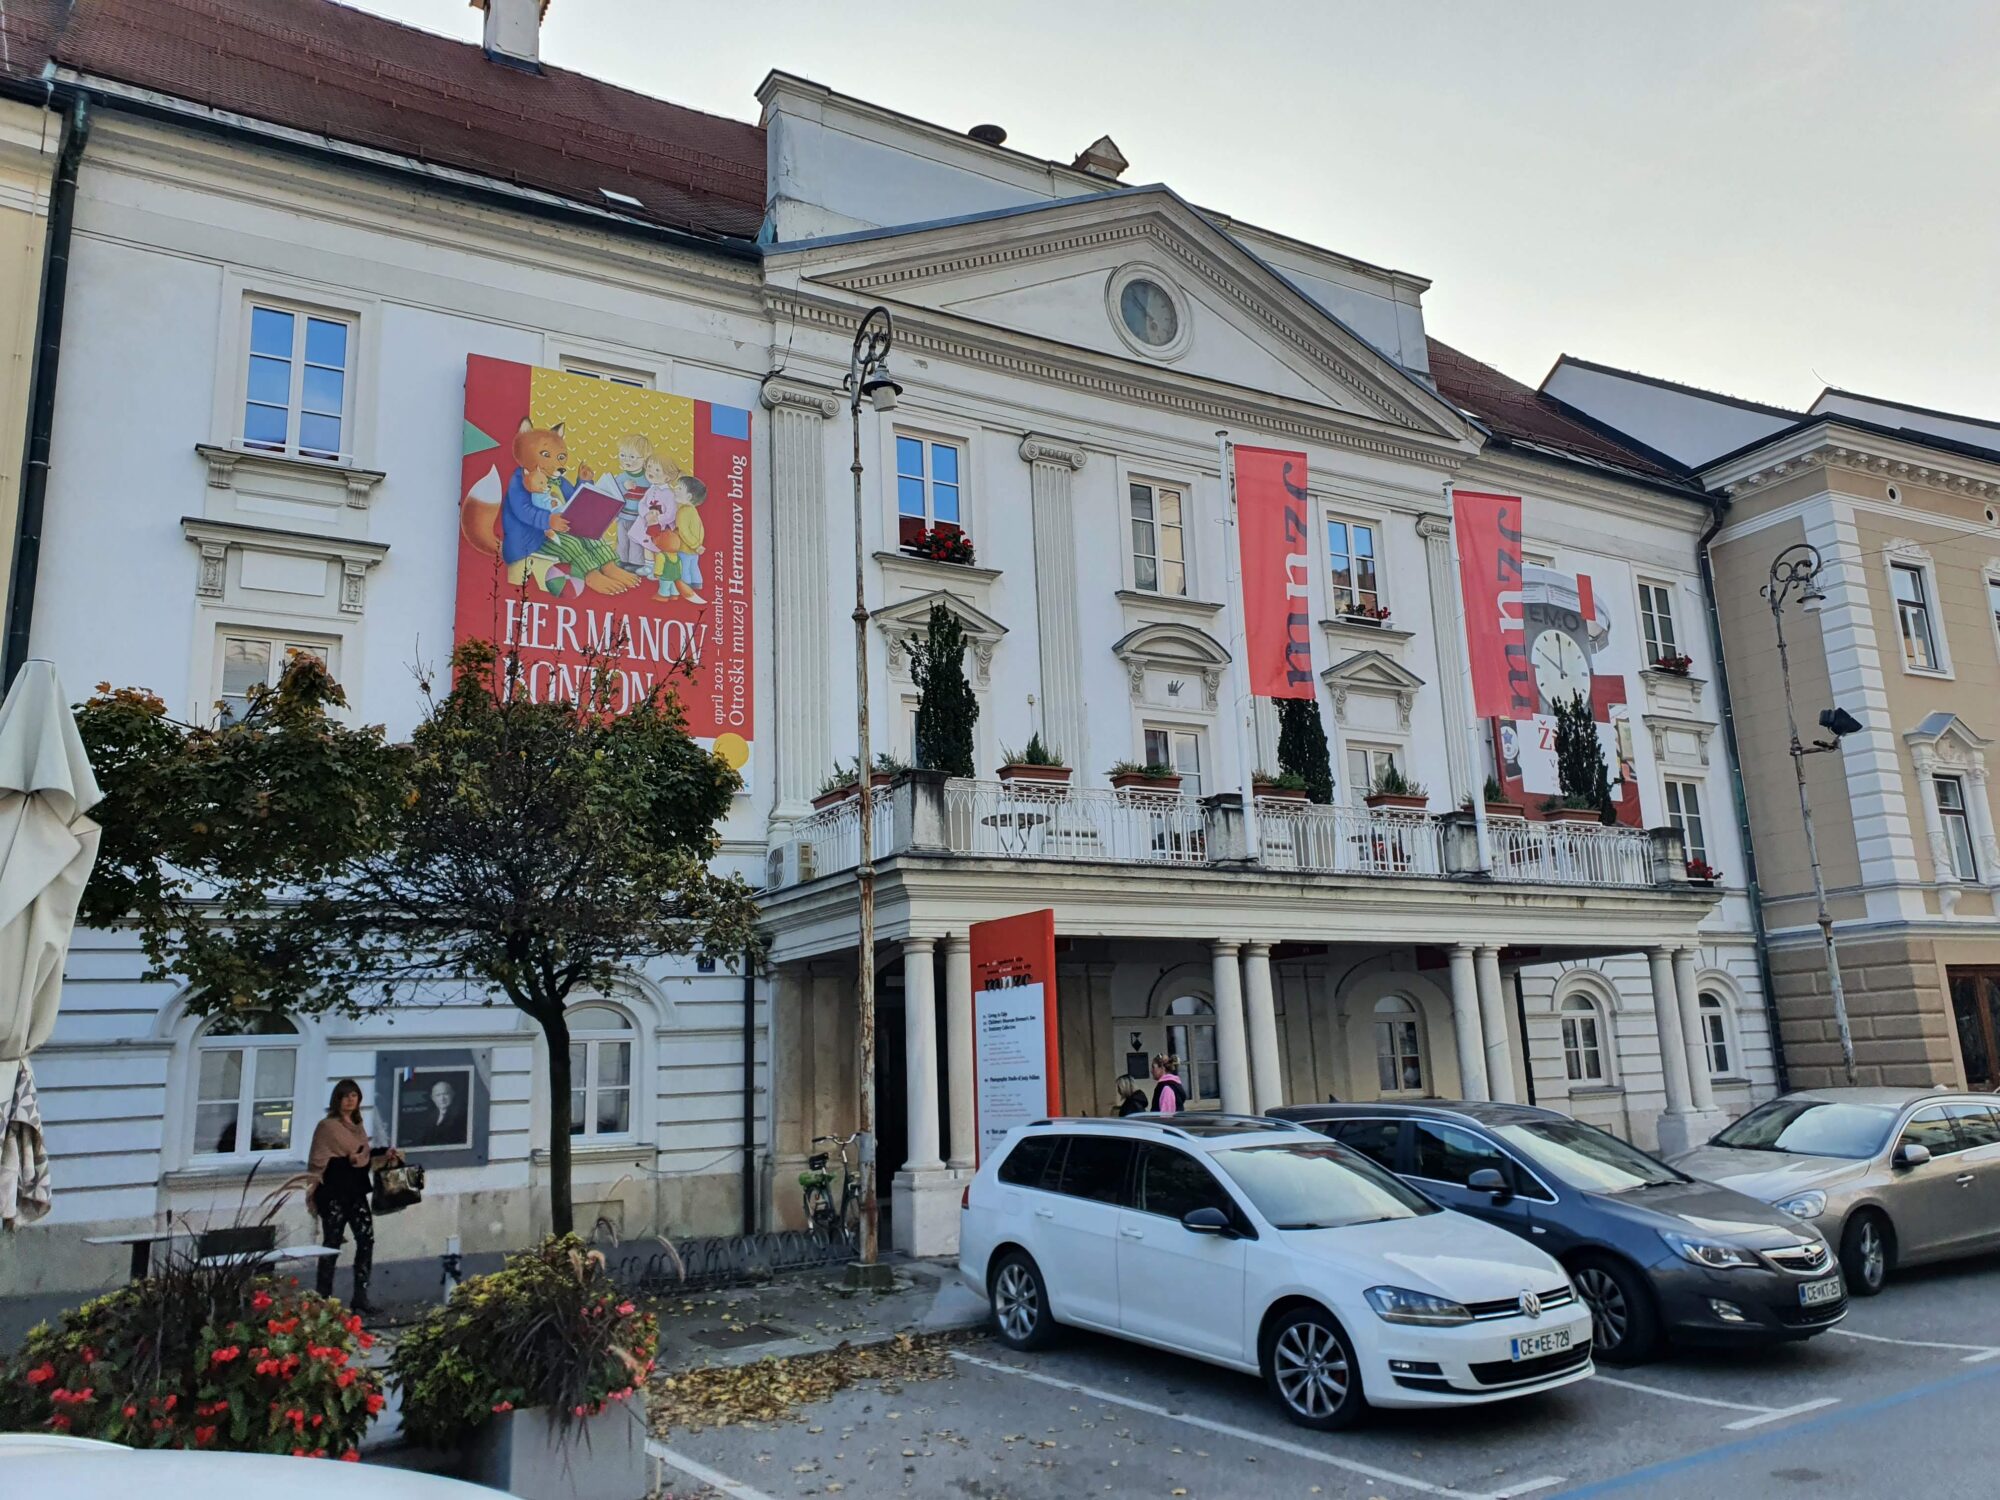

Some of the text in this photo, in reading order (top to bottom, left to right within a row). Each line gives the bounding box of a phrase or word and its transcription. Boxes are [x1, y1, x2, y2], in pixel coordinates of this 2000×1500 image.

[714, 551, 724, 581] 2022
[727, 455, 748, 726] Otroški muzej Hermanov brlog
[711, 586, 724, 645] december
[503, 598, 708, 666] HERMANOV
[714, 661, 724, 691] 2021
[711, 694, 726, 725] april
[1520, 1338, 1534, 1356] CE
